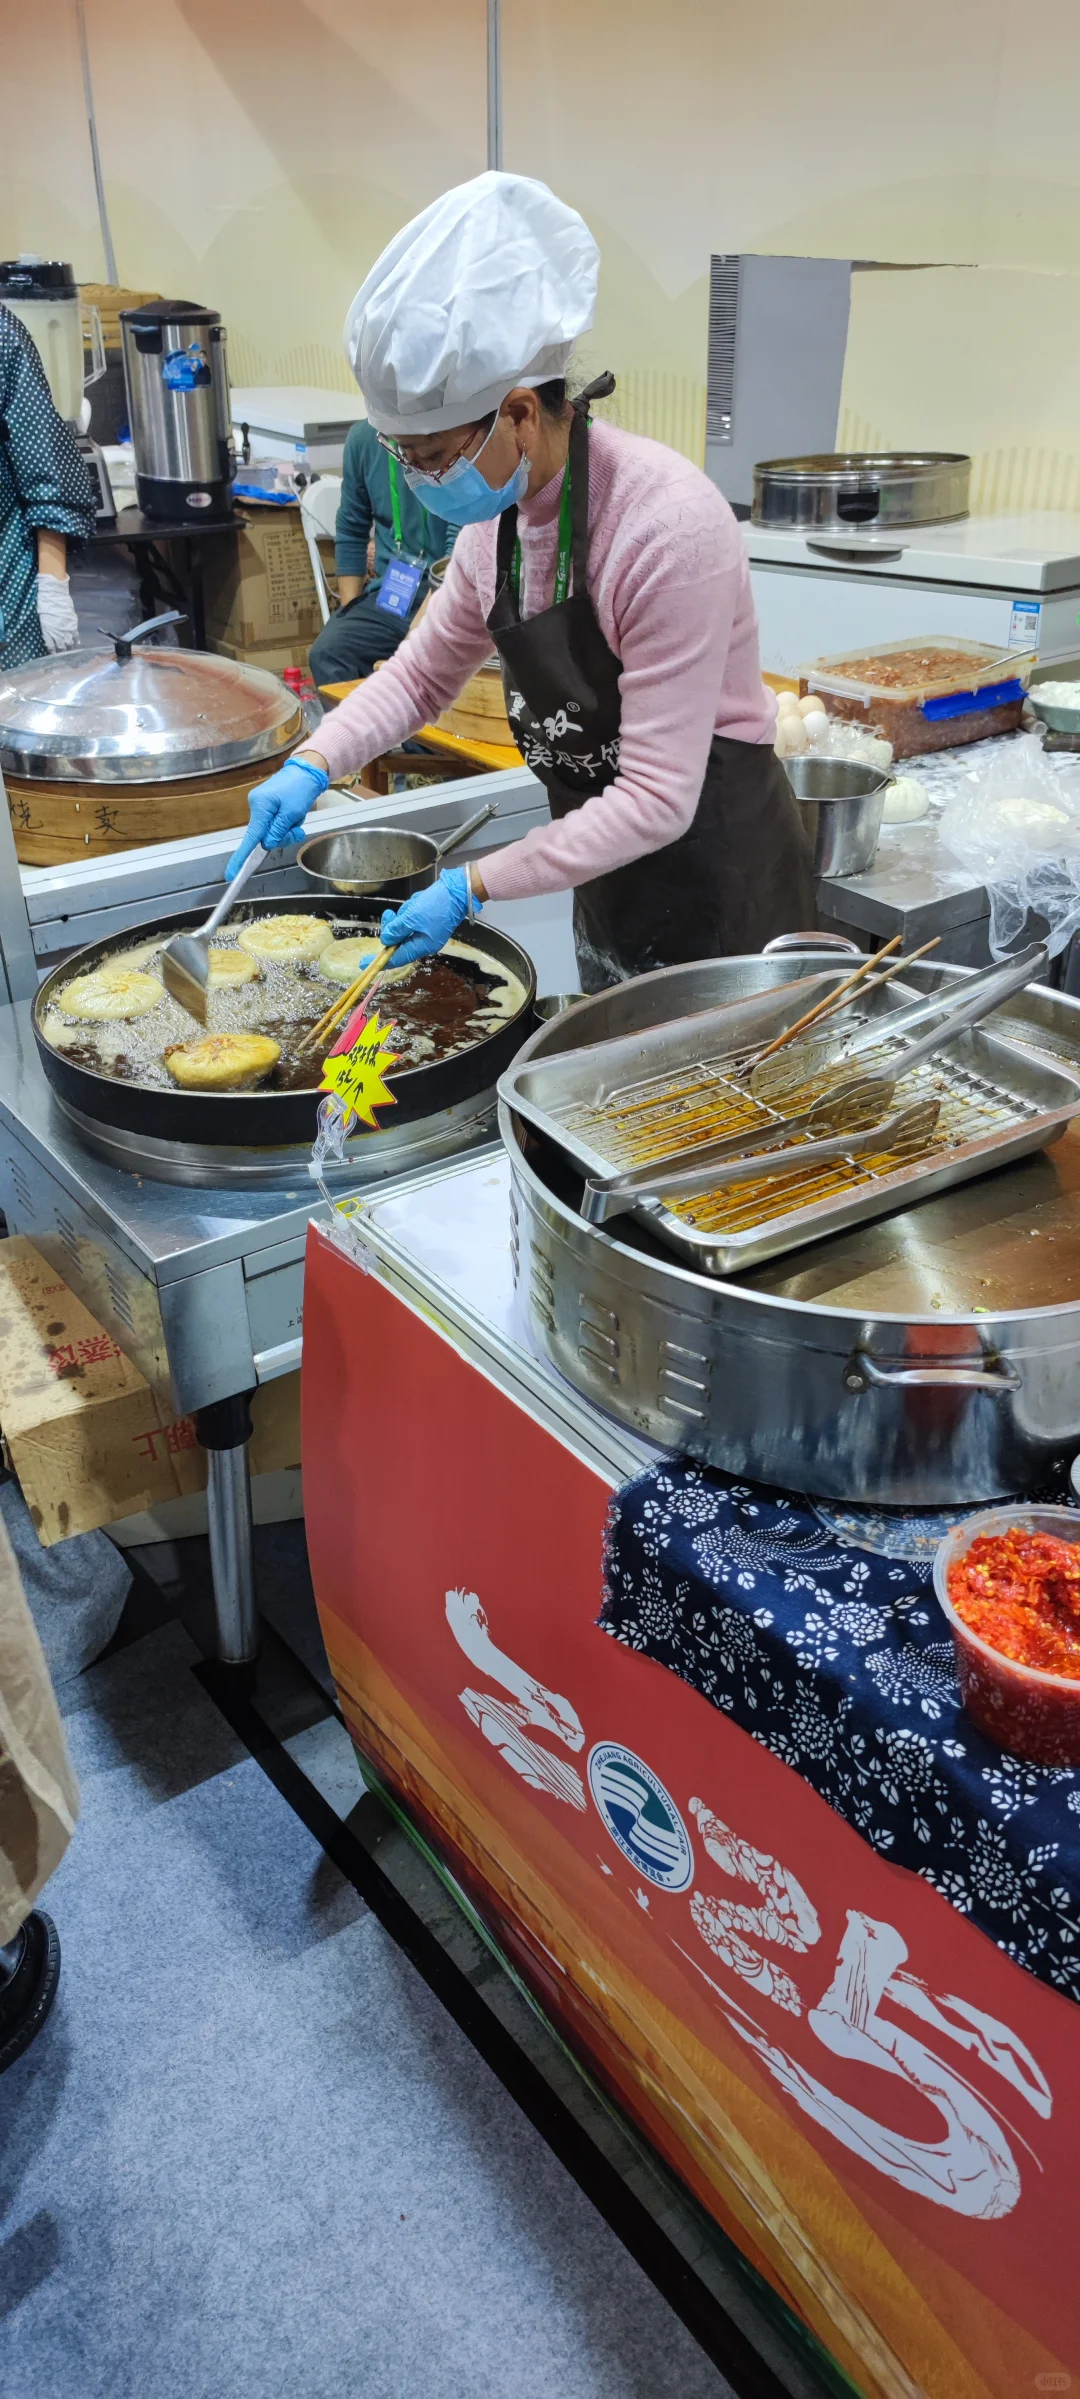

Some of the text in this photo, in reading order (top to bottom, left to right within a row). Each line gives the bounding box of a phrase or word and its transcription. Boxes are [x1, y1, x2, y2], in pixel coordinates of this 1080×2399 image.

[594, 1751, 687, 1856] ZHEJIANG AGRICULTURAL FAIR
